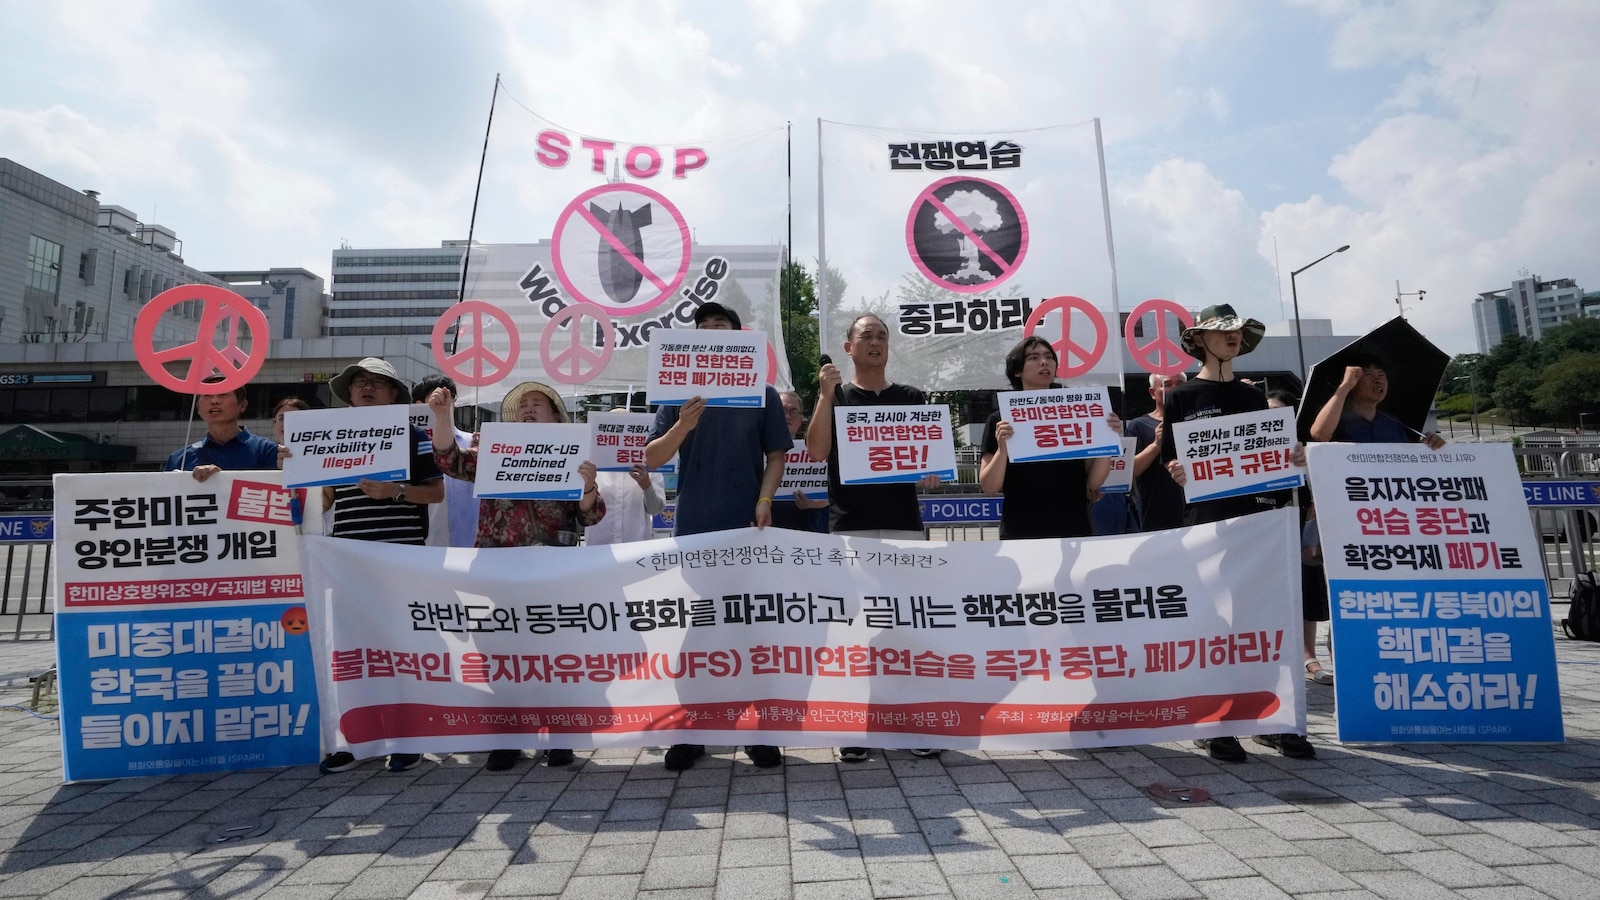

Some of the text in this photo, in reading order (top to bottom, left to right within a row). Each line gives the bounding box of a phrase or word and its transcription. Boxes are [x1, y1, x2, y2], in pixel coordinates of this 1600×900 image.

[536, 130, 708, 179] STOP
[888, 140, 1023, 170] 전쟁연습
[519, 264, 583, 327] Wa
[661, 353, 754, 369] 한미 연합연습
[0, 375, 29, 384] GS25
[658, 371, 758, 387] 전면 폐기하라!
[1009, 393, 1101, 406] 한반도/동북아 평화 파괴
[846, 411, 942, 424] 중국, 러시아 겨냥한
[1010, 403, 1105, 423] 한미연합연습
[291, 425, 405, 443] USFK Strategic
[596, 435, 619, 446] 한미
[847, 424, 943, 442] 한미연합연습
[1033, 421, 1092, 448] 중단!
[1187, 419, 1284, 444] 유엔사를 대중 작전
[303, 440, 393, 456] Flexibility Is
[490, 443, 580, 457] Stop ROK-US
[616, 449, 644, 464] 중단
[868, 445, 929, 472] 중단!
[1186, 436, 1290, 459] 수행기구로 강화하려는
[1420, 454, 1438, 463] 반대
[1439, 454, 1453, 463] 1인
[1455, 454, 1476, 464] 시위>
[322, 455, 367, 469] Illegal
[501, 457, 566, 469] Combined
[1192, 448, 1290, 481] 미국 규탄!
[495, 471, 563, 483] Exercises
[1345, 476, 1488, 502] 을지자유방패
[1548, 487, 1585, 501] LINE
[74, 493, 219, 531] 주한미군
[931, 503, 990, 517] POLICE
[1356, 507, 1490, 535] 연습 중단과
[75, 530, 277, 570] 양안분쟁 개입
[650, 544, 785, 571] 한미연합전쟁연습
[790, 546, 822, 567] 중단
[827, 547, 861, 567] 촉구
[865, 550, 933, 569] 기자회견
[1343, 542, 1523, 570] 확장억제 폐기로
[68, 578, 302, 603] 한미상호방위조약/국제법 위반
[407, 584, 1188, 635] 한반도와 동북아 평화를 파괴하고, 끝내는 핵전쟁을 불러올
[1338, 590, 1542, 619] 한반도/동북아의
[87, 617, 286, 659] 미중대결에
[1377, 626, 1513, 664] 핵대결을
[331, 630, 1284, 684] 불법적인 을지자유방패(UFS) 한미연합연습을 즉각 중단, 폐기하라!
[90, 660, 294, 706] 한국을 끌어
[1373, 672, 1538, 711] 해소하라!
[80, 704, 310, 750] 들이지 말라!
[442, 713, 469, 725] 일시
[479, 713, 518, 727] 2025년
[521, 714, 541, 727] 8월
[546, 713, 593, 727] 18일(월)
[596, 713, 622, 727] 오전
[627, 711, 653, 725] 11시
[685, 709, 714, 722] 장소
[723, 708, 752, 722] 용산
[754, 706, 807, 723] 대통령실
[810, 708, 908, 725] 인근(전쟁기념관
[911, 712, 939, 726] 정문
[941, 711, 961, 727] 앞)
[996, 709, 1024, 723] 주최
[1036, 705, 1189, 724] 평화와통일을여는사람들
[1478, 724, 1512, 735] (SPARK)
[228, 752, 265, 764] (SPARK)
